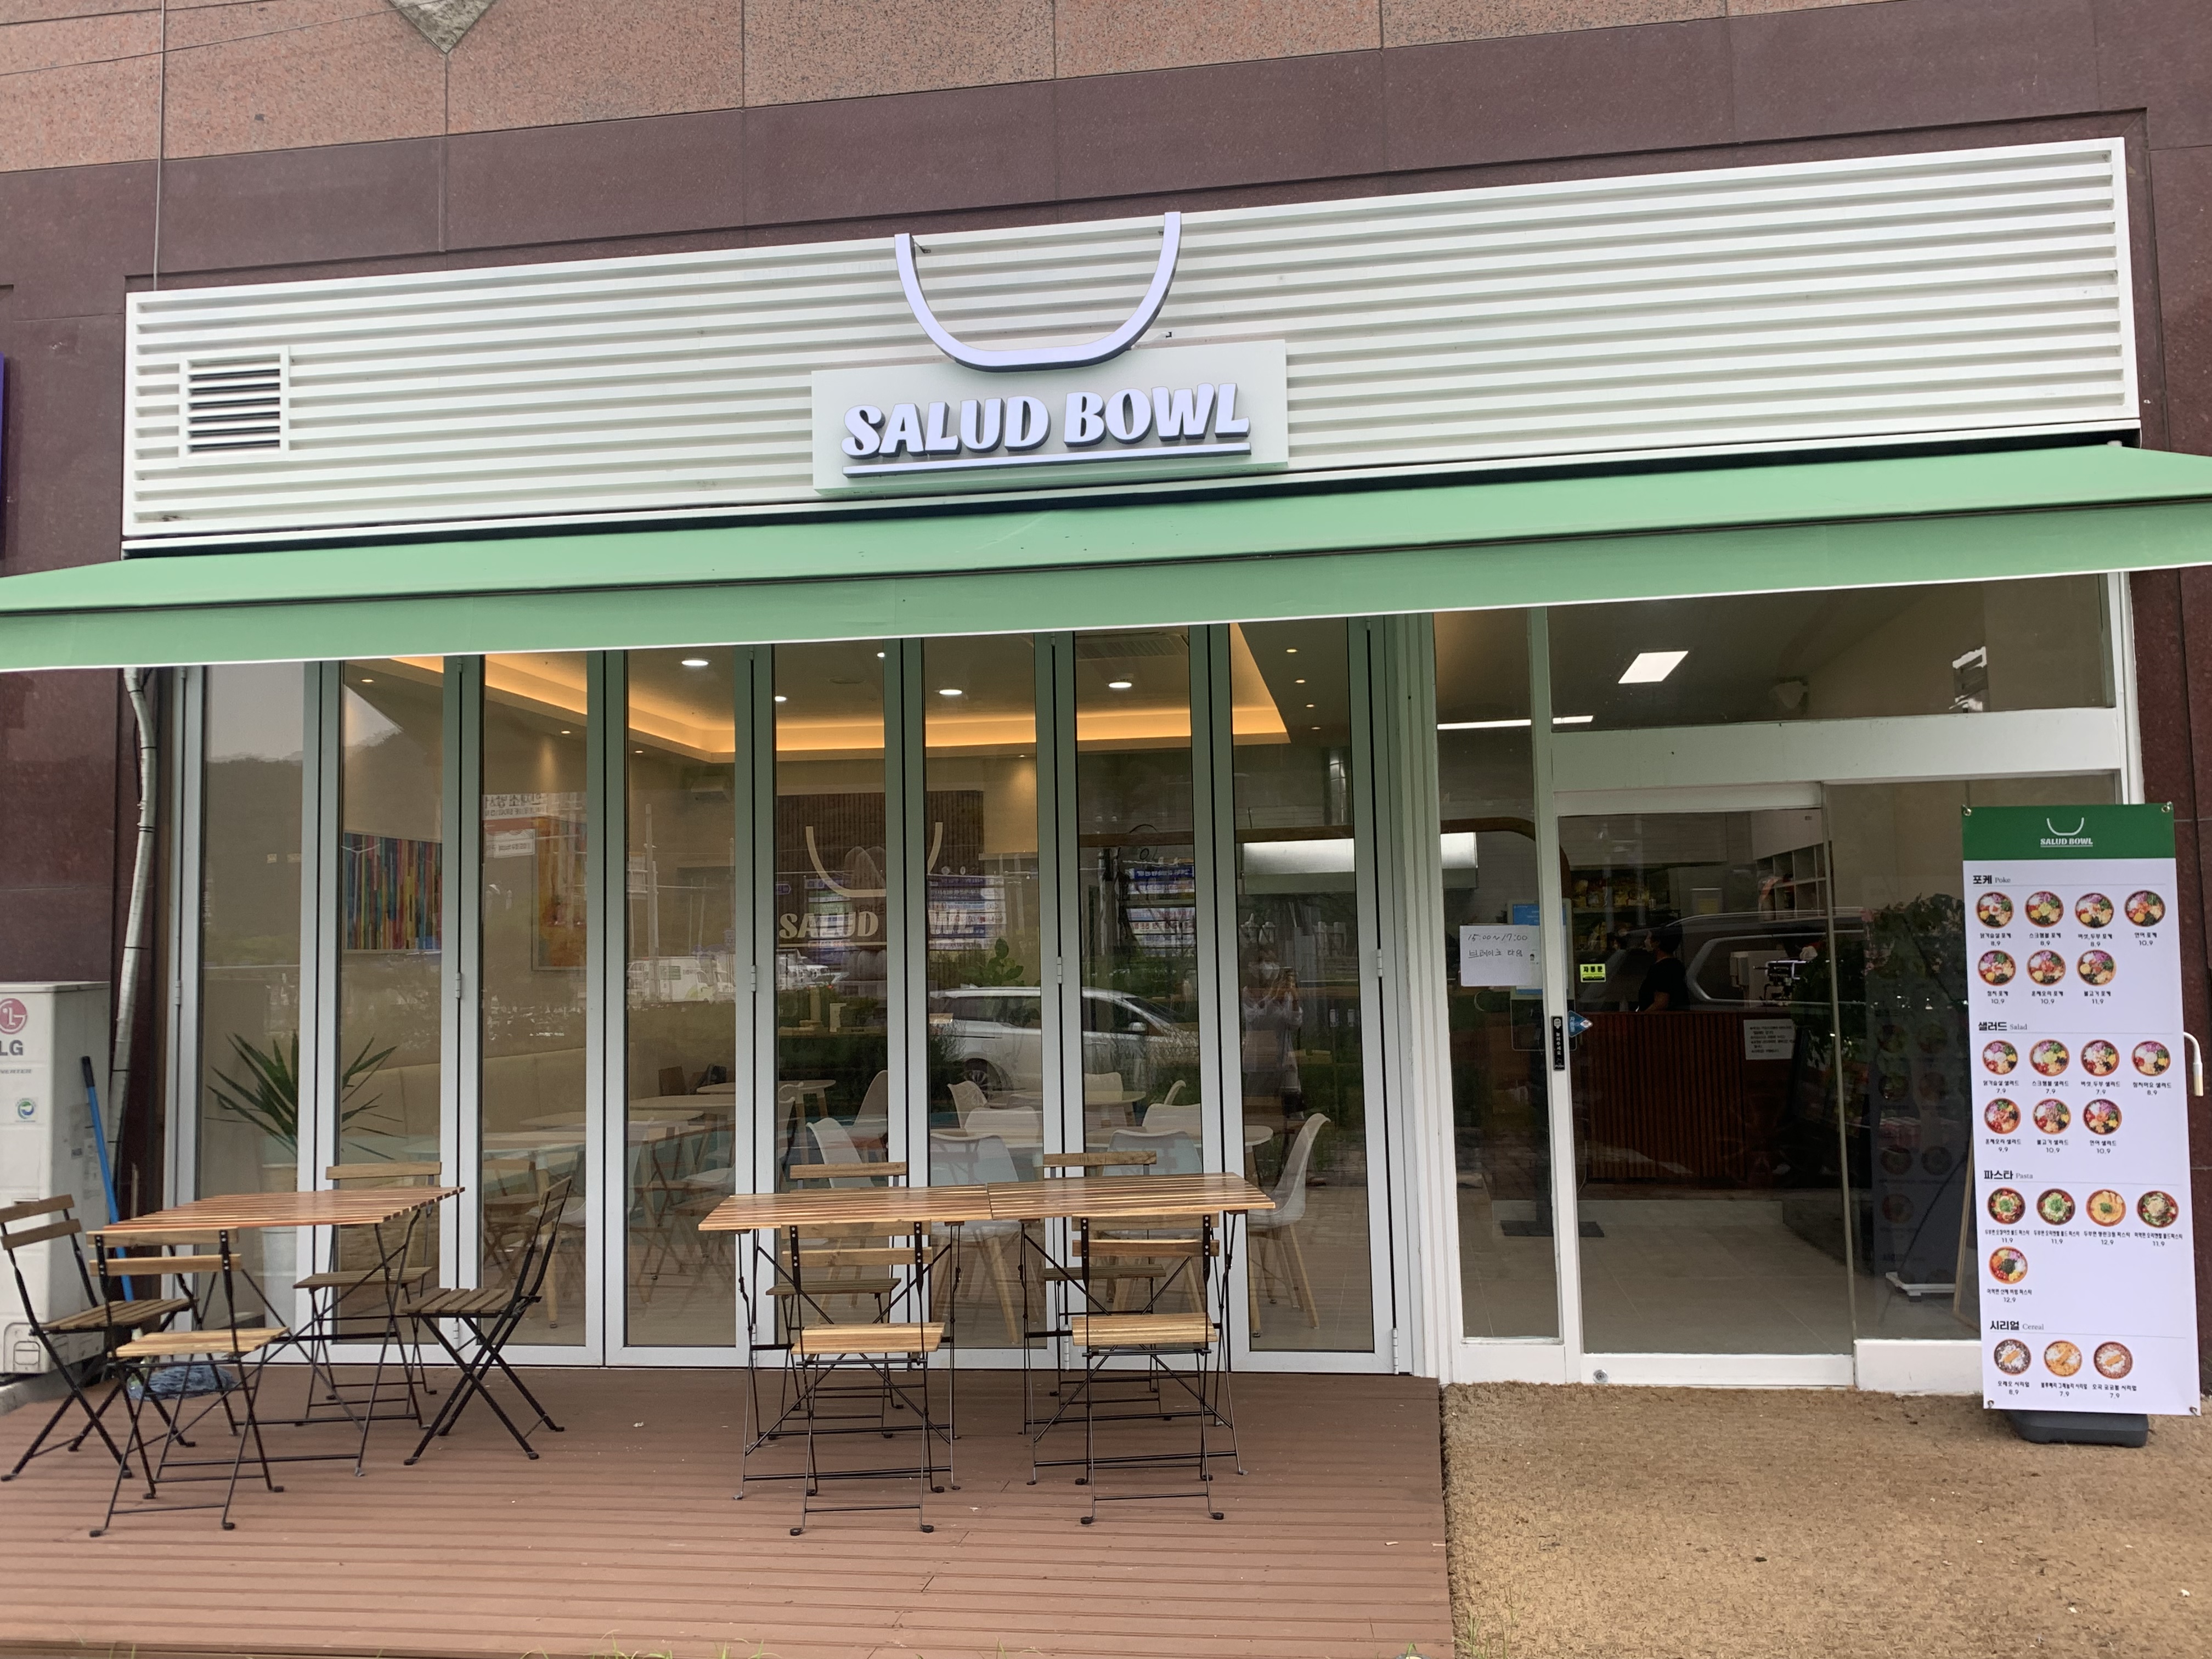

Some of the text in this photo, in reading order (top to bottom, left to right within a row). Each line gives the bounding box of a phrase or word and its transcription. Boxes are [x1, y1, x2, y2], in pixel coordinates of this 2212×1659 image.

[841, 383, 1251, 460] SALUD BOWL
[1973, 875, 1992, 884] 포케
[779, 911, 878, 939] SALUD
[1978, 1021, 2007, 1031] 샐러드
[0, 1040, 23, 1056] LG
[1984, 1170, 2013, 1180] 파스타
[1990, 1321, 2019, 1331] 시리얼
